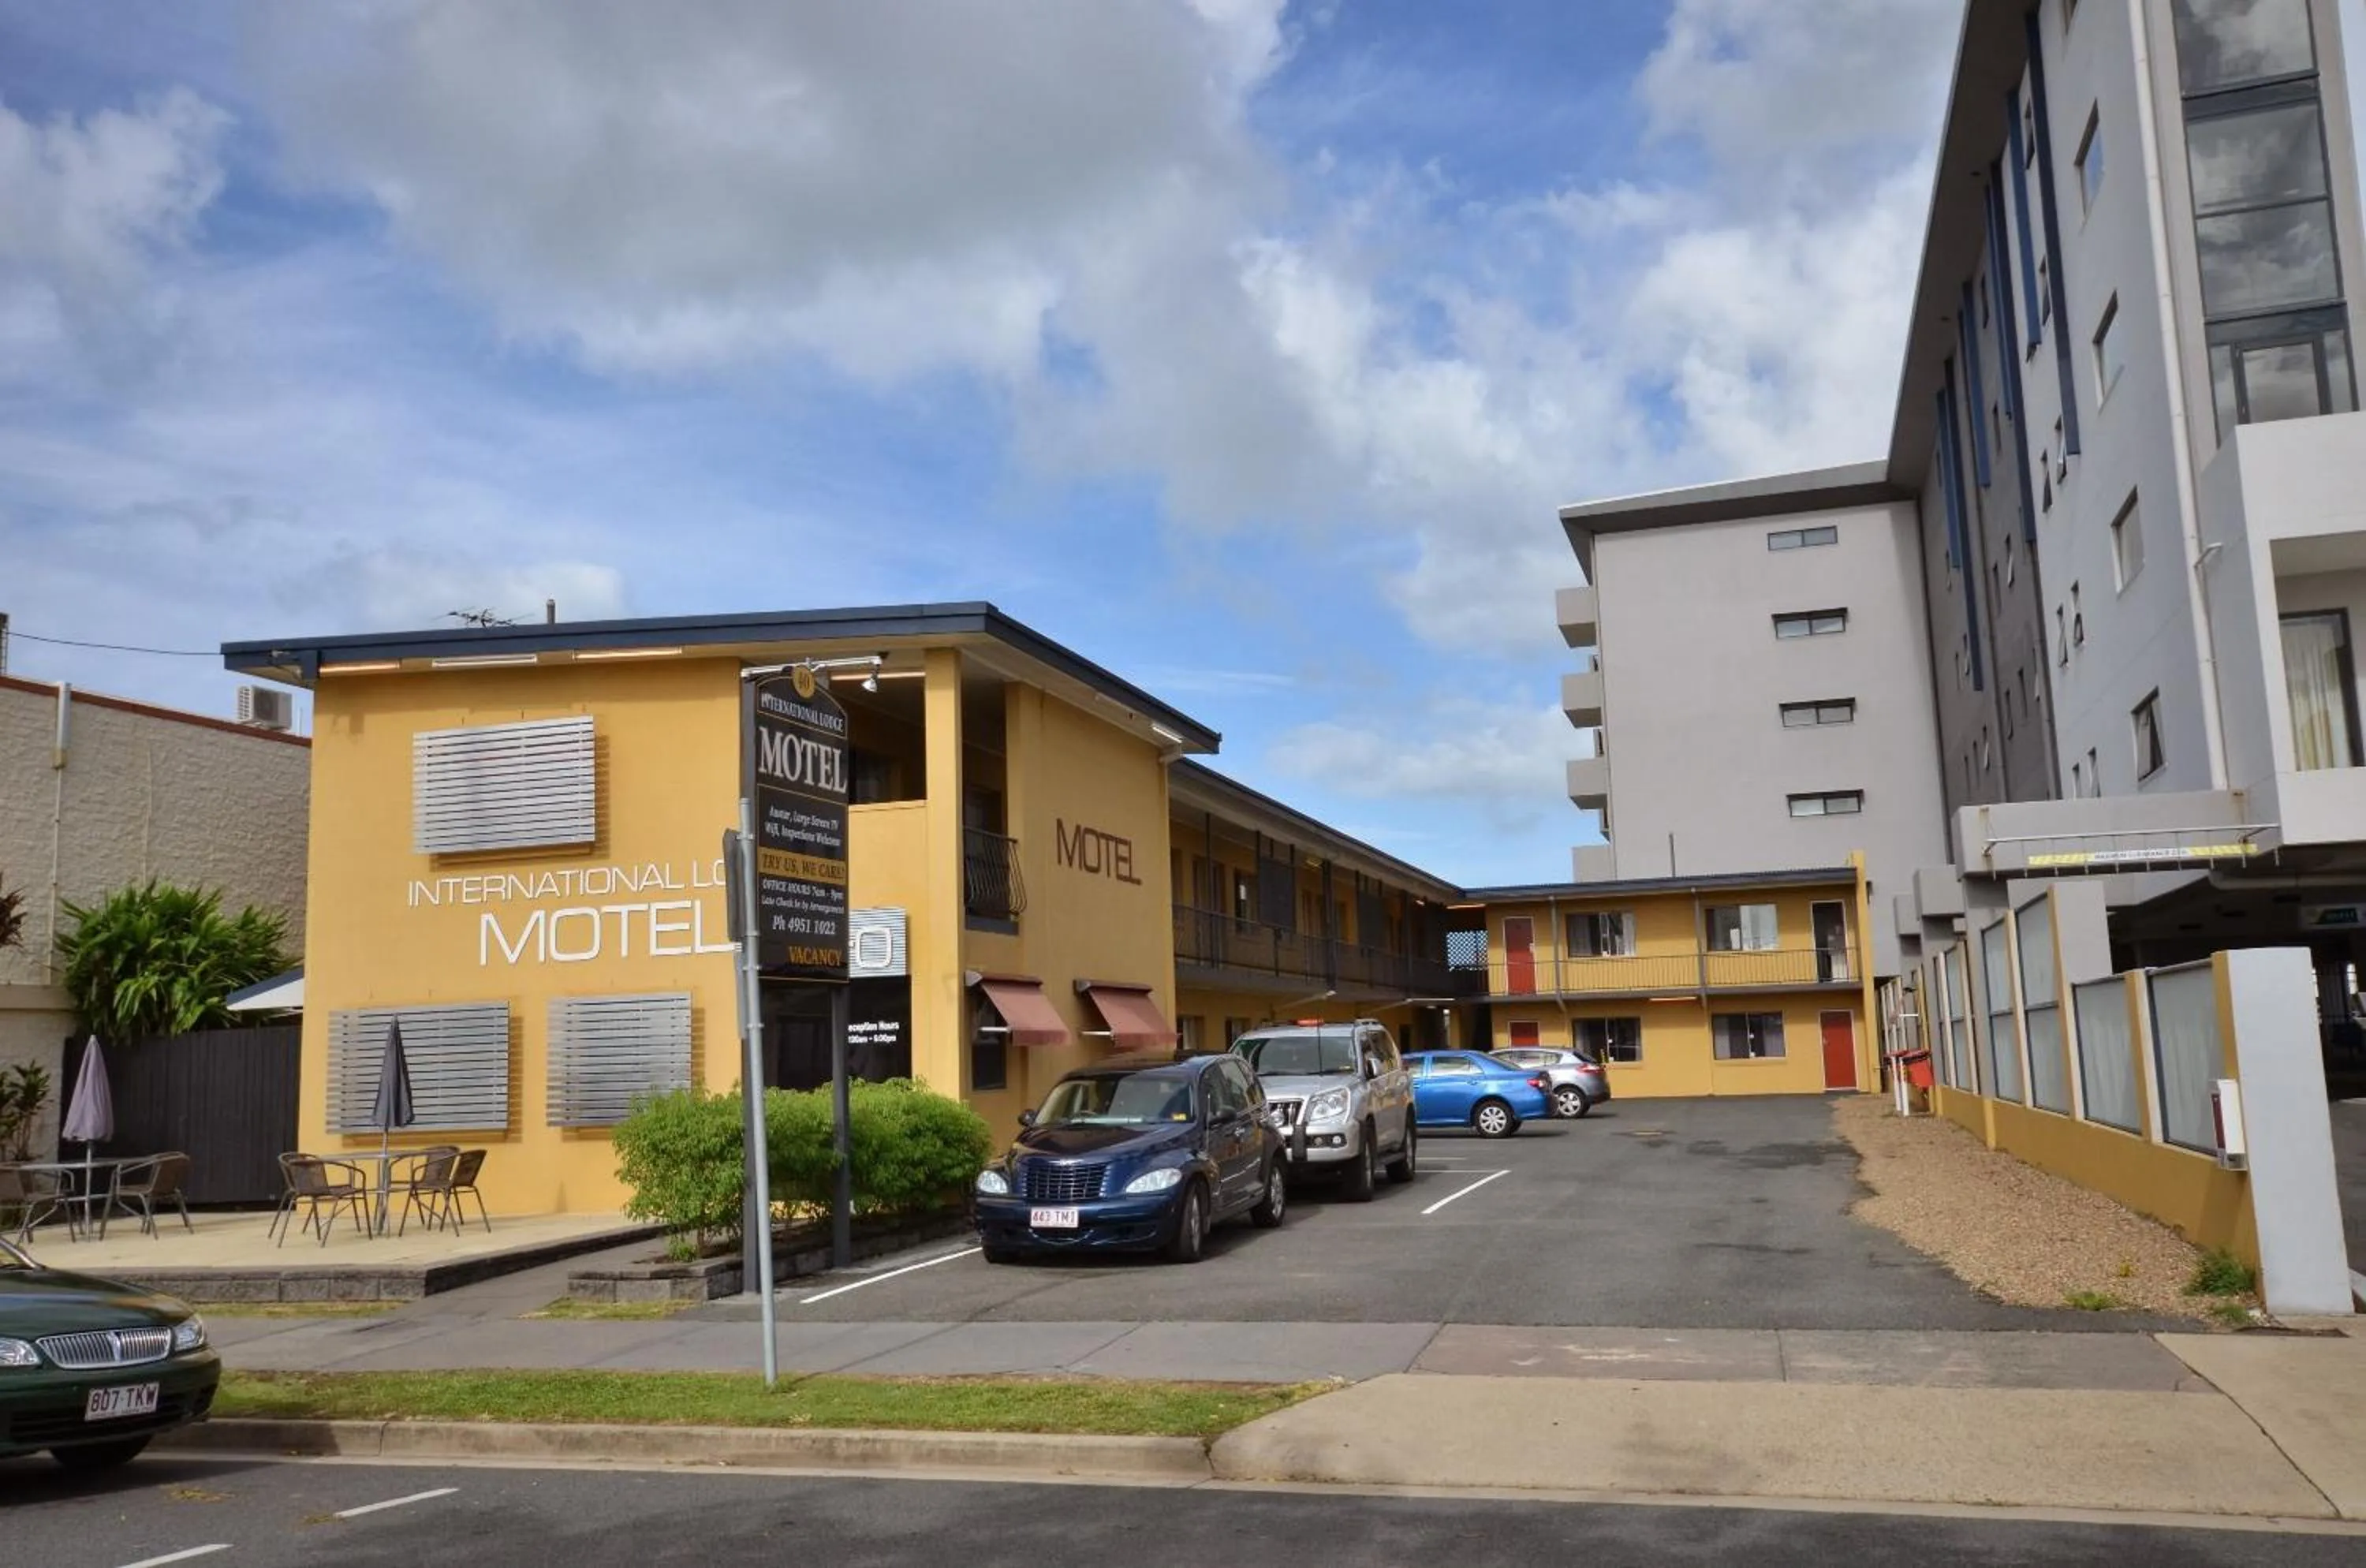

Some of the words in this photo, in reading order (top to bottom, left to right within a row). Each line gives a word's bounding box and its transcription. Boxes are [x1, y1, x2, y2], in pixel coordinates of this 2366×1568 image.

[761, 692, 819, 724] INTERNATIONAL
[819, 712, 844, 733] LODGE
[758, 726, 848, 793] MOTEL
[763, 853, 782, 869] TRY
[784, 857, 799, 875] US,
[802, 861, 817, 876] WE
[1056, 817, 1142, 886] MOTEL
[408, 861, 685, 906] INTERNATIONAL
[763, 878, 786, 892] OFFICE
[480, 898, 741, 966] MOTEL
[773, 915, 786, 930] Ph
[788, 917, 811, 934] 4951
[789, 946, 842, 966] VACANCY
[848, 1021, 877, 1033] eception
[879, 1020, 899, 1030] Hours
